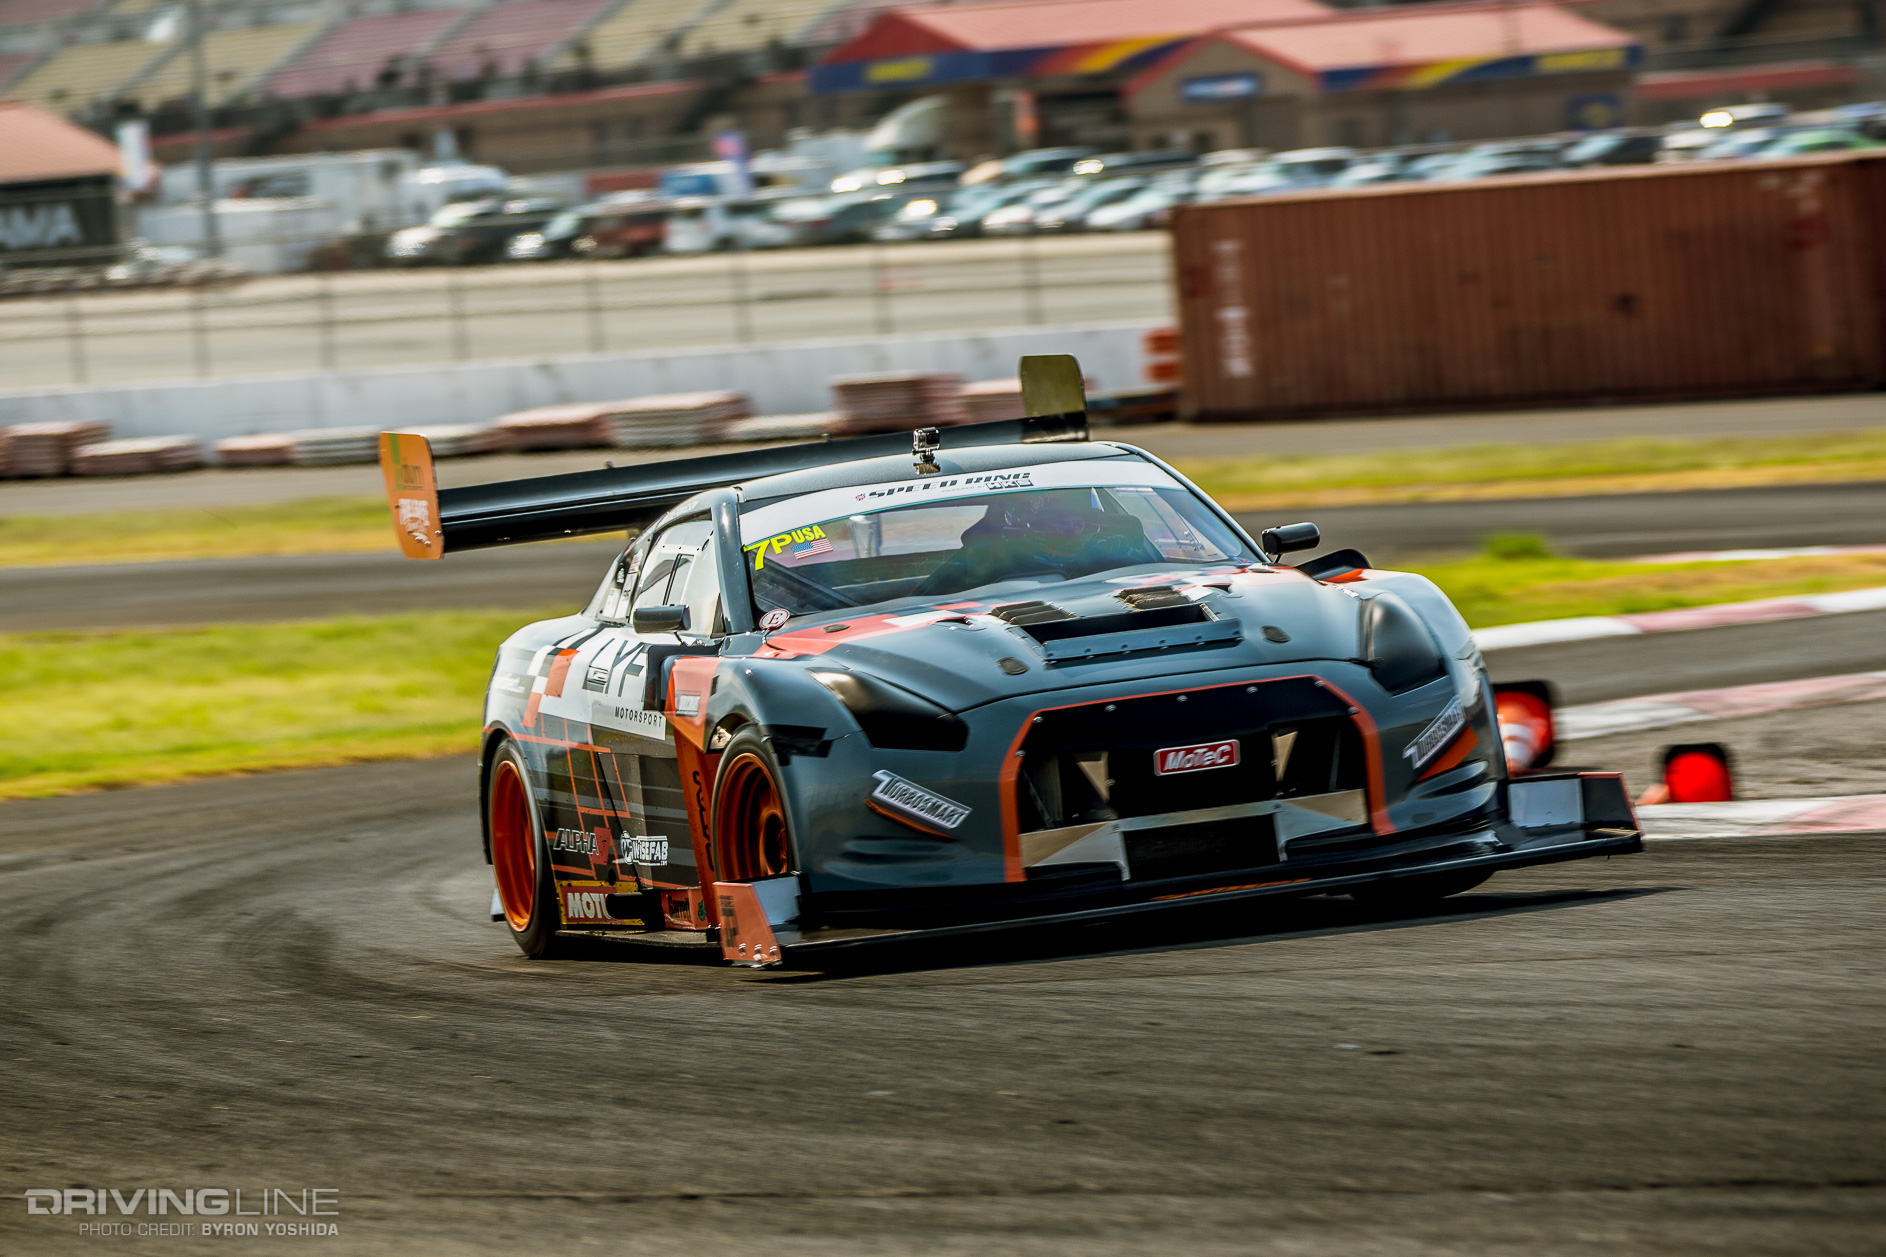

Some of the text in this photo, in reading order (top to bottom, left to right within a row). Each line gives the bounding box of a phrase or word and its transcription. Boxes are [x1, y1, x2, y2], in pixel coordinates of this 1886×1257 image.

[868, 480, 958, 499] SPEED
[965, 472, 1031, 485] RING
[985, 479, 1034, 490] HKS
[791, 525, 826, 544] USA
[615, 706, 662, 727] MOTORSPORT
[1163, 745, 1232, 771] MoTeC
[872, 769, 973, 829] TURBOSMART
[553, 828, 599, 855] ALPHA
[632, 841, 669, 861] WISEFAB
